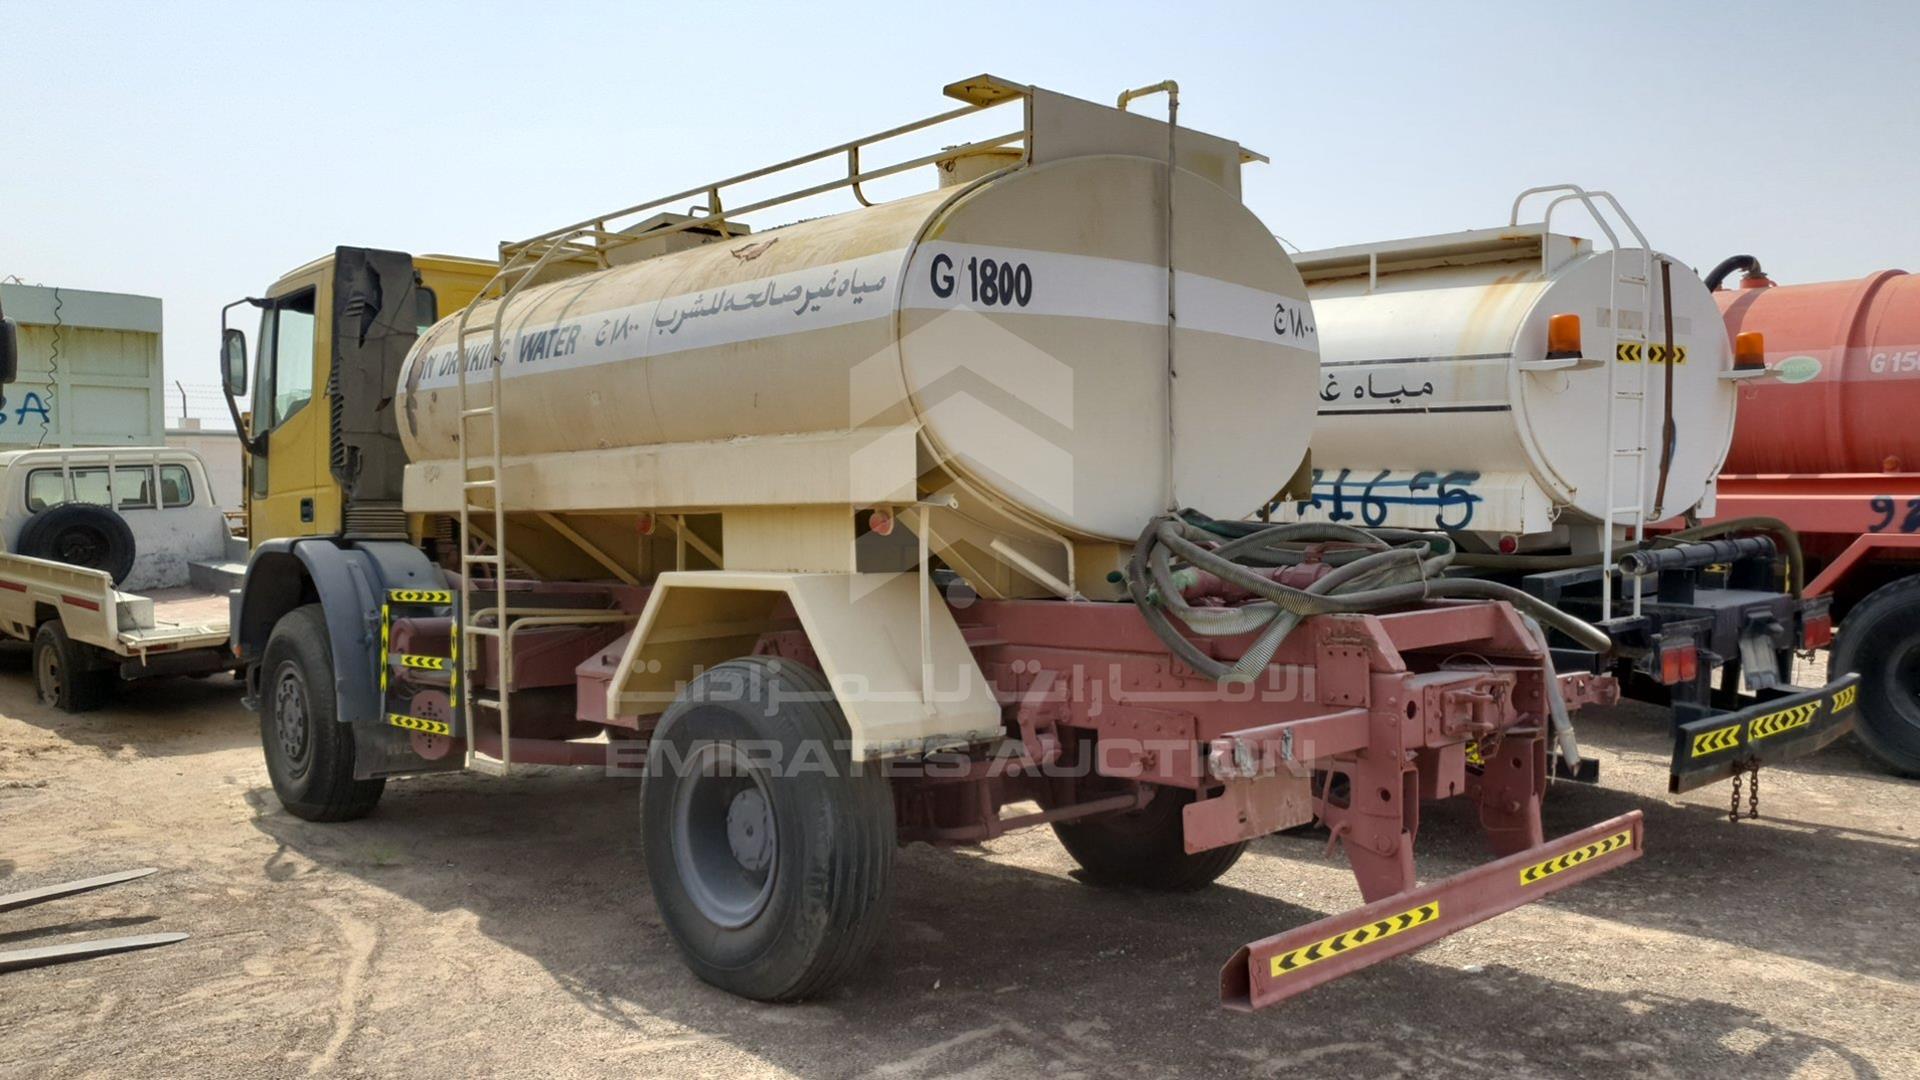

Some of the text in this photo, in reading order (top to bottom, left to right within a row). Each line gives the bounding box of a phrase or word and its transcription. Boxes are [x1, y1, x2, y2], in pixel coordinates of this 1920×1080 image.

[518, 324, 582, 363] WATER
[1891, 351, 1920, 373] 15
[1353, 373, 1434, 404] مياه
